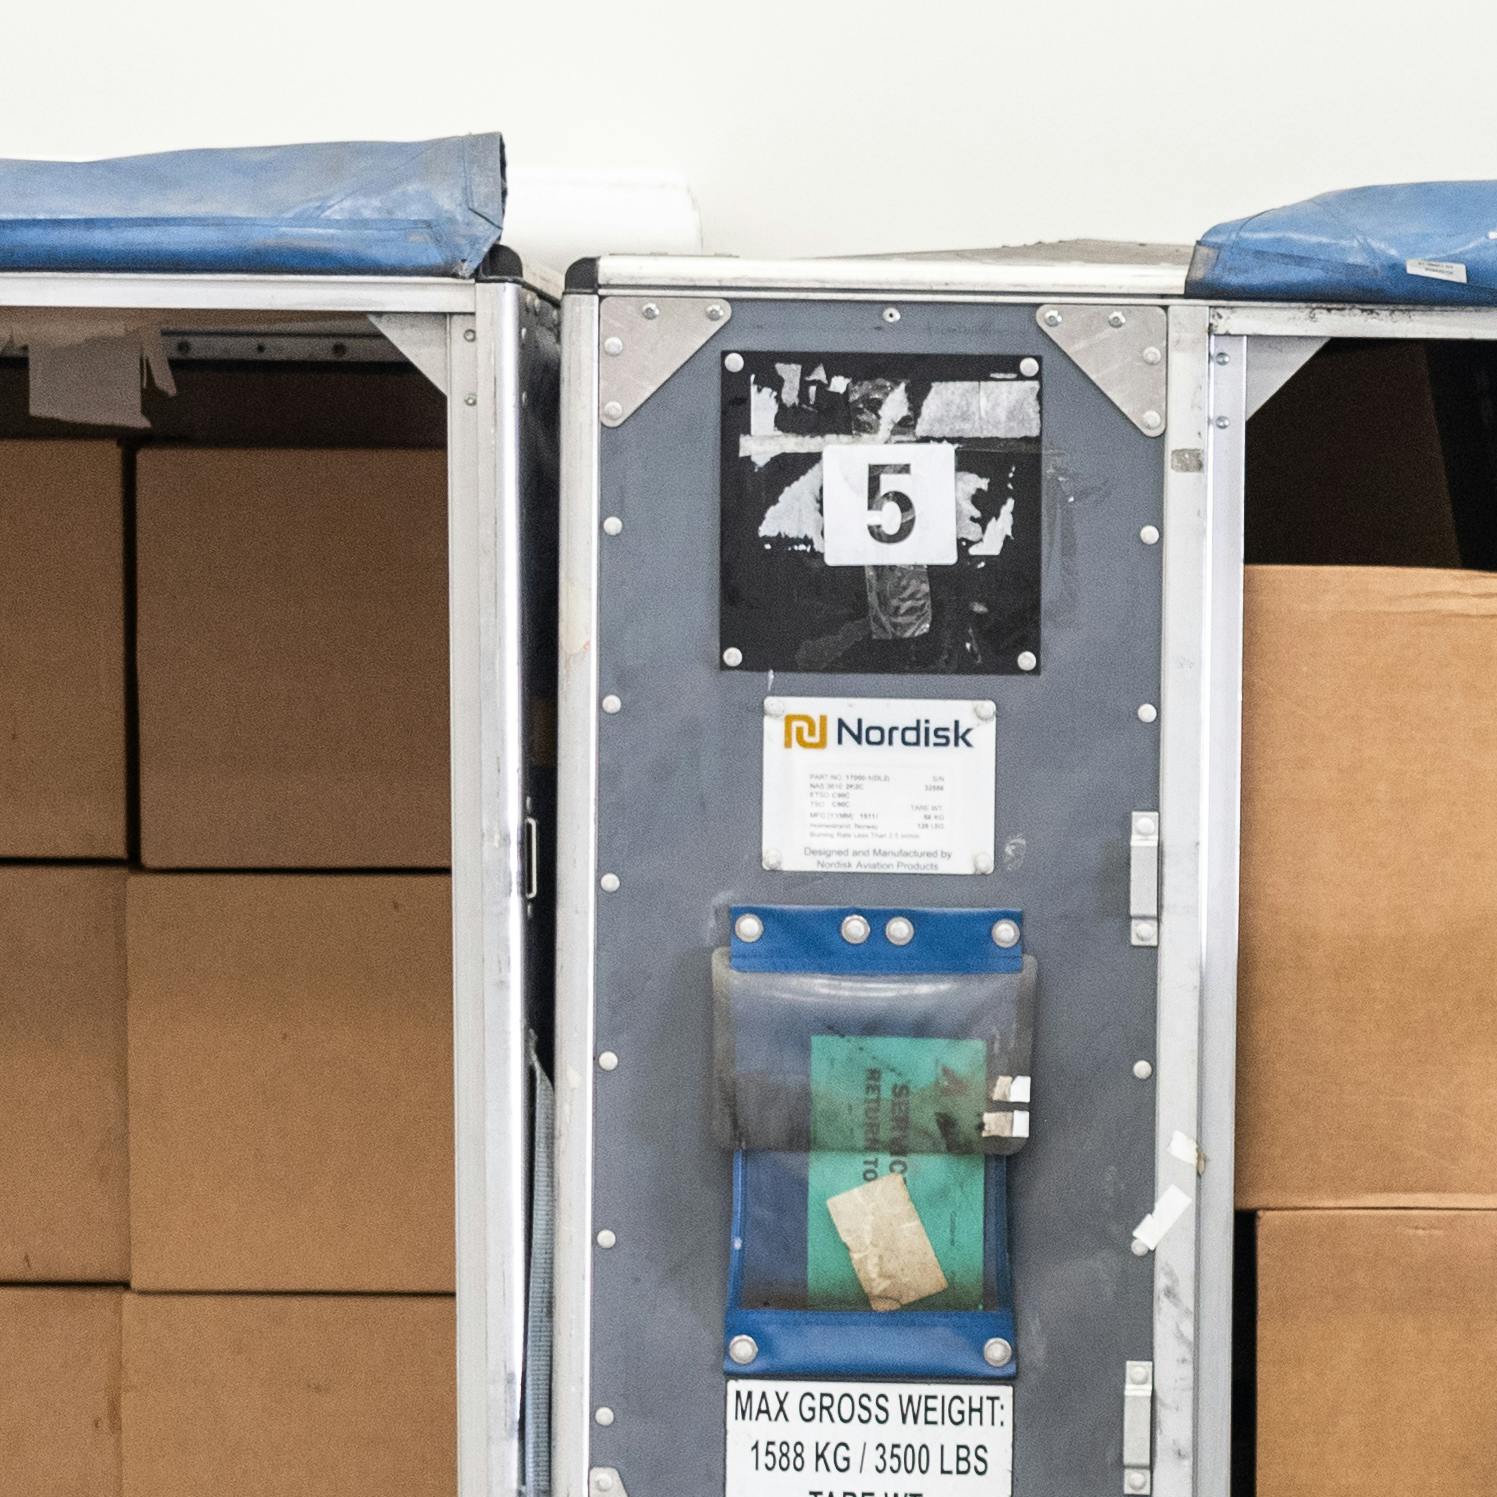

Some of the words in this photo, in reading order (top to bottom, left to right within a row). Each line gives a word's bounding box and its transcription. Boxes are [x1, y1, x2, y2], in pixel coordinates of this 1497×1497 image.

[866, 463, 916, 545] 5
[836, 716, 975, 749] Nordisk
[804, 847, 849, 859] Designed
[852, 848, 869, 859] and
[872, 848, 939, 860] Manufactured
[940, 849, 952, 861] by
[816, 859, 853, 870] Nordisk
[855, 860, 895, 871] Aviation
[896, 861, 939, 872] Products
[734, 1390, 789, 1422] MAX
[798, 1391, 889, 1424] GROSS
[899, 1393, 1005, 1427] WEIGHT:
[751, 1440, 805, 1472] 1588
[815, 1442, 851, 1473] KG
[859, 1442, 866, 1474] /
[874, 1443, 930, 1475] 3500
[940, 1445, 989, 1476] LBS
